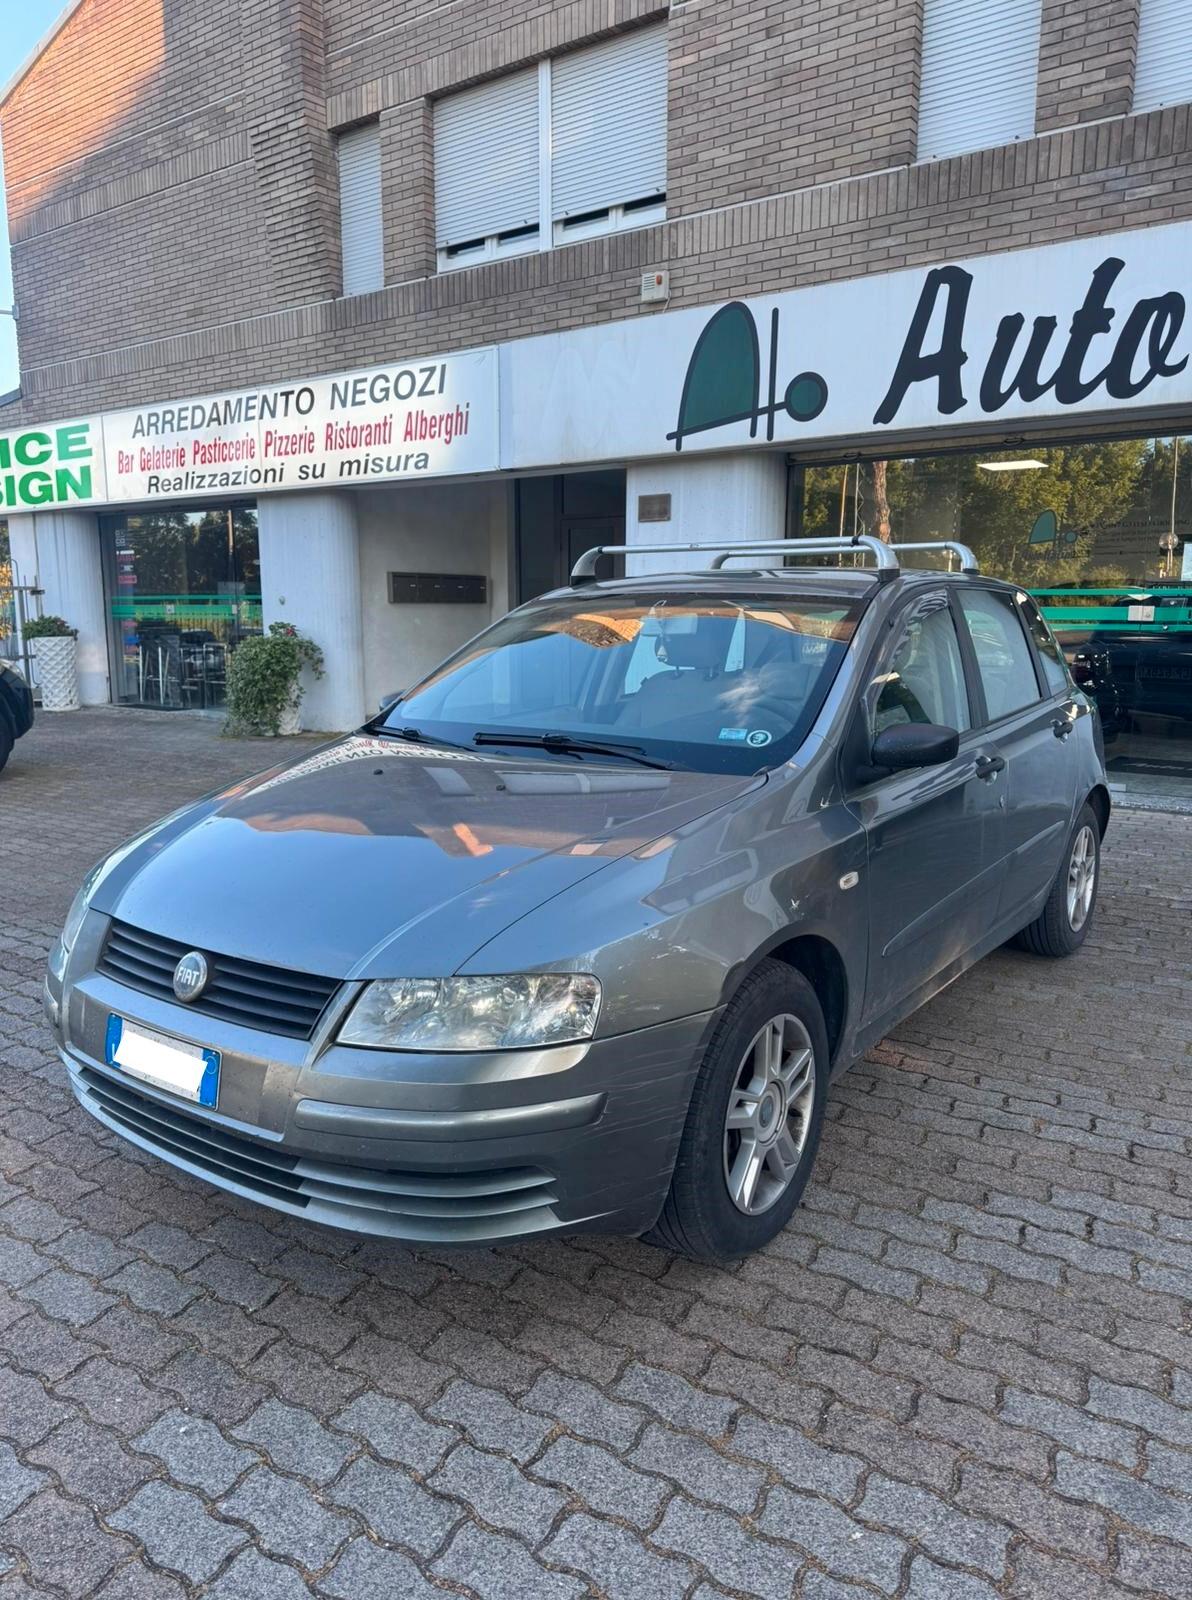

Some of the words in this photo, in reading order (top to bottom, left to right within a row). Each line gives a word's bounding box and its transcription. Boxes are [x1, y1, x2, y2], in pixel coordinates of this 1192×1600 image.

[873, 257, 1190, 425] Auto
[132, 387, 315, 439] ARREDAMENTO
[330, 364, 447, 411] NEGOZI
[0, 424, 93, 466] ICE
[118, 450, 134, 474] Bar
[139, 442, 186, 472] Gelaterie
[193, 432, 256, 465] Pasticcerie
[264, 426, 315, 458] Pizzerie
[325, 414, 393, 451] Ristoranti
[404, 402, 470, 444] Alberghi
[0, 465, 92, 506] IGN
[147, 462, 285, 493] Realizzazioni
[298, 462, 326, 480] su
[339, 452, 430, 477] misura
[176, 966, 200, 986] FIAT
